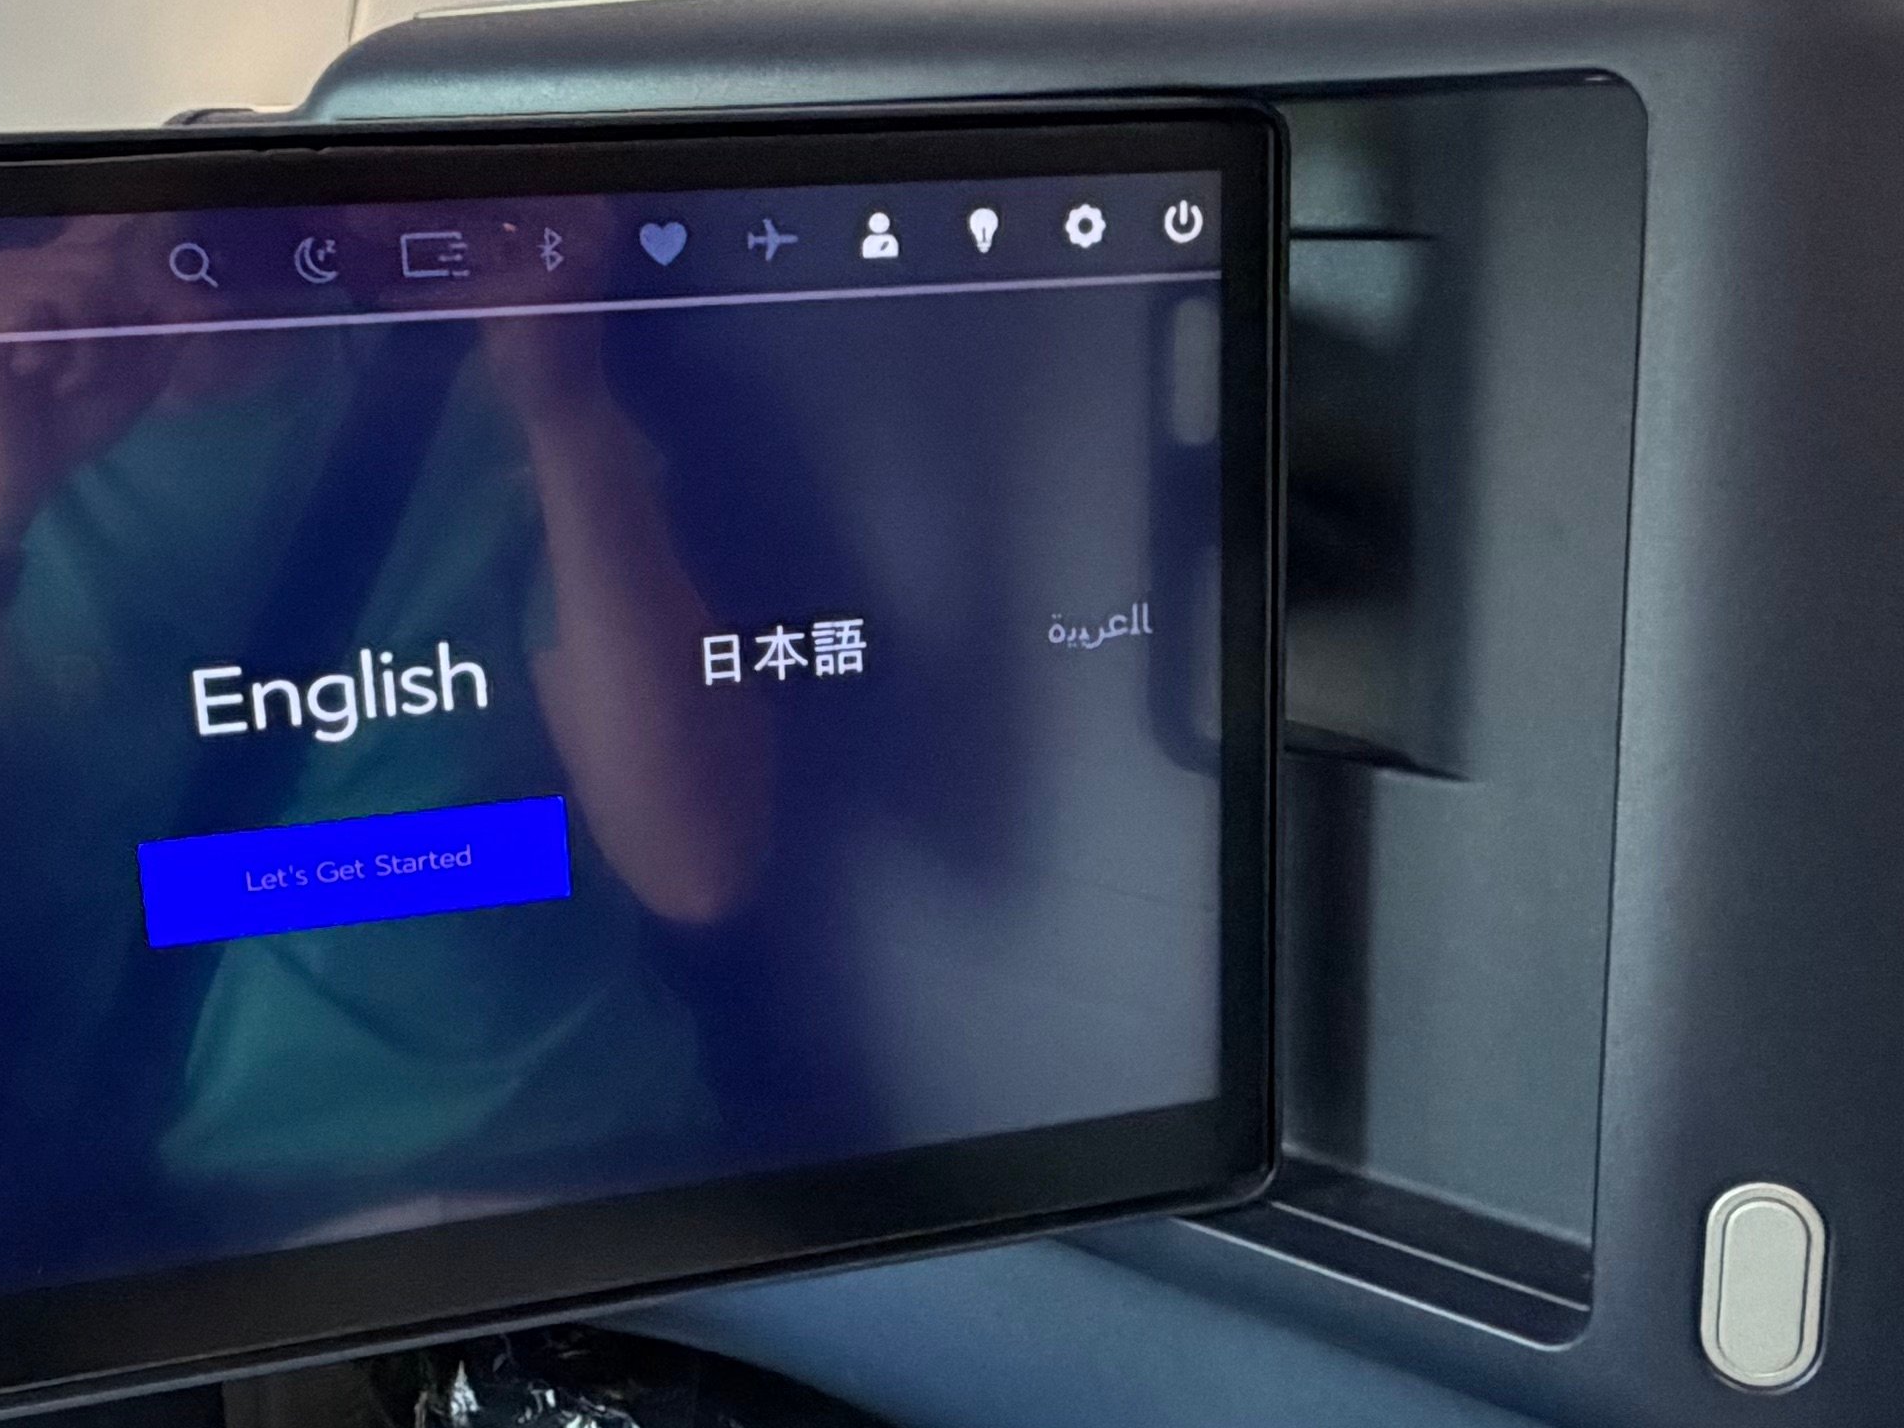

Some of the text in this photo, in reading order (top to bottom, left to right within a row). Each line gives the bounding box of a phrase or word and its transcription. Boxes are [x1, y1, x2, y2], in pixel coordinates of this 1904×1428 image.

[700, 618, 866, 685] 日本語
[190, 641, 490, 742] English
[245, 844, 473, 892] Let's Get Started
